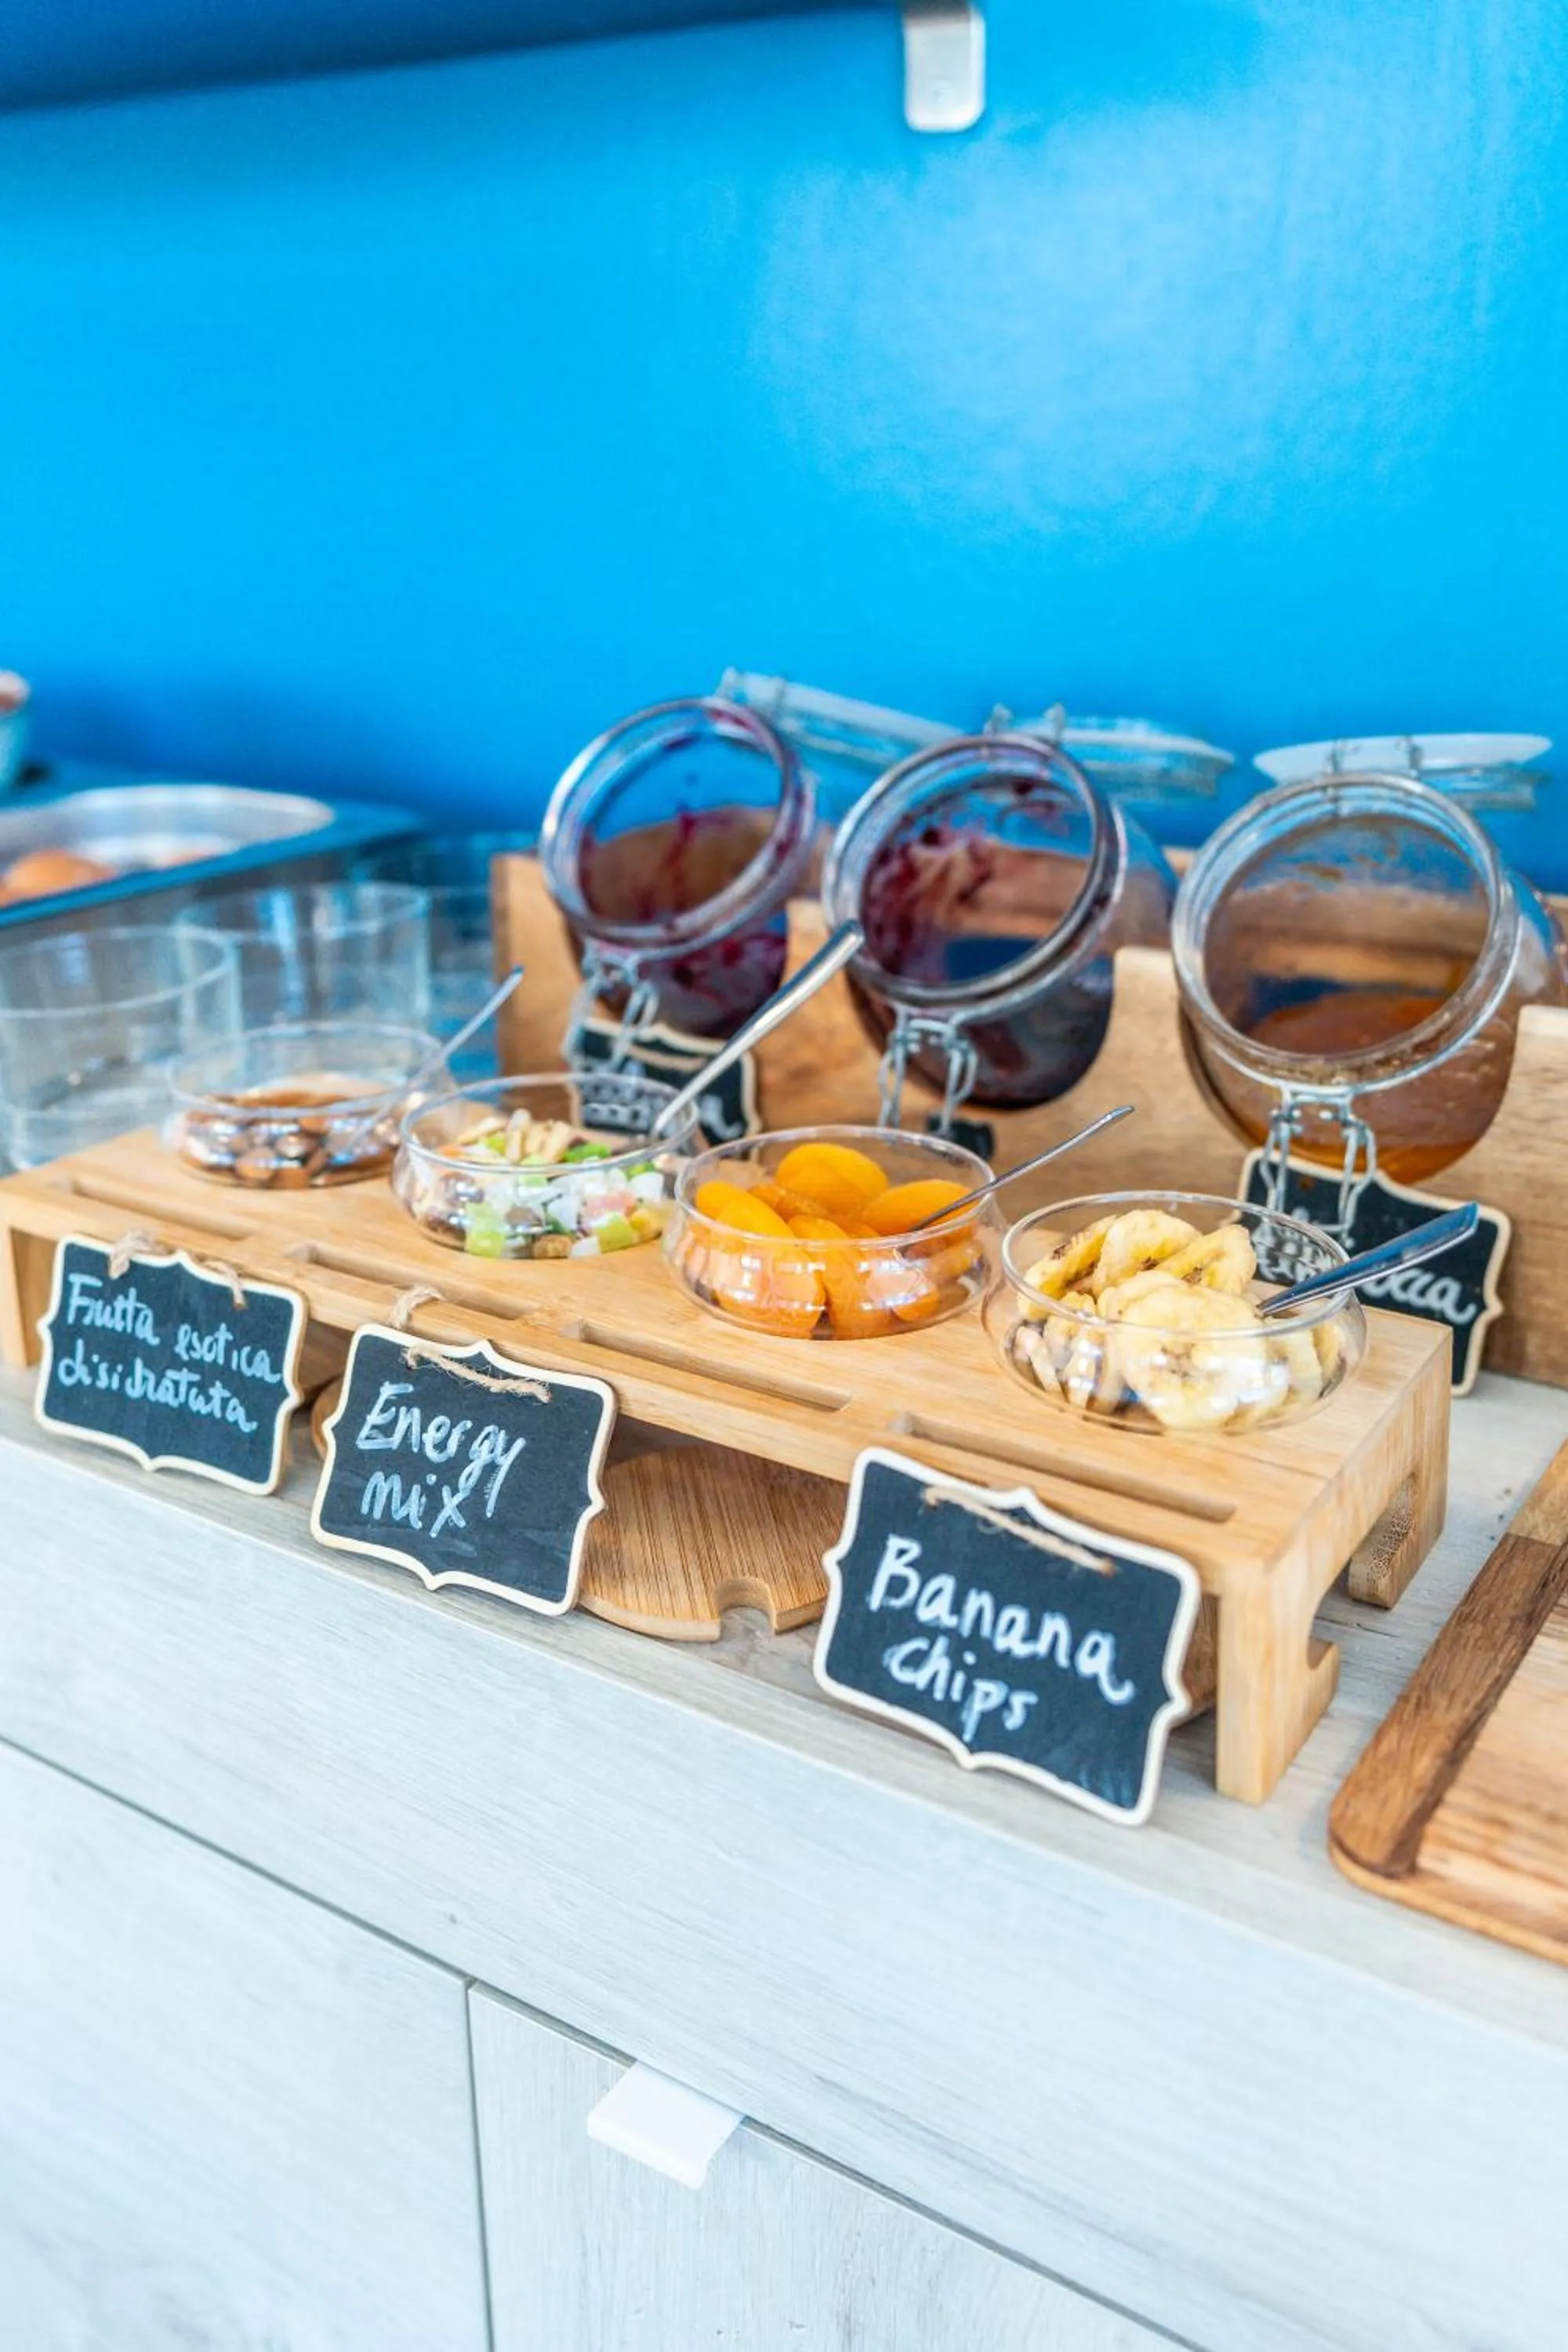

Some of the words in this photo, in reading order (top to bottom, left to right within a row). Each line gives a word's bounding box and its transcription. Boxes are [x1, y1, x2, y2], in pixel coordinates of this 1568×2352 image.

[67, 1273, 160, 1345] Frutta
[176, 1323, 281, 1383] esotica
[356, 1381, 526, 1518] Energy
[868, 1534, 1134, 1704] Banana
